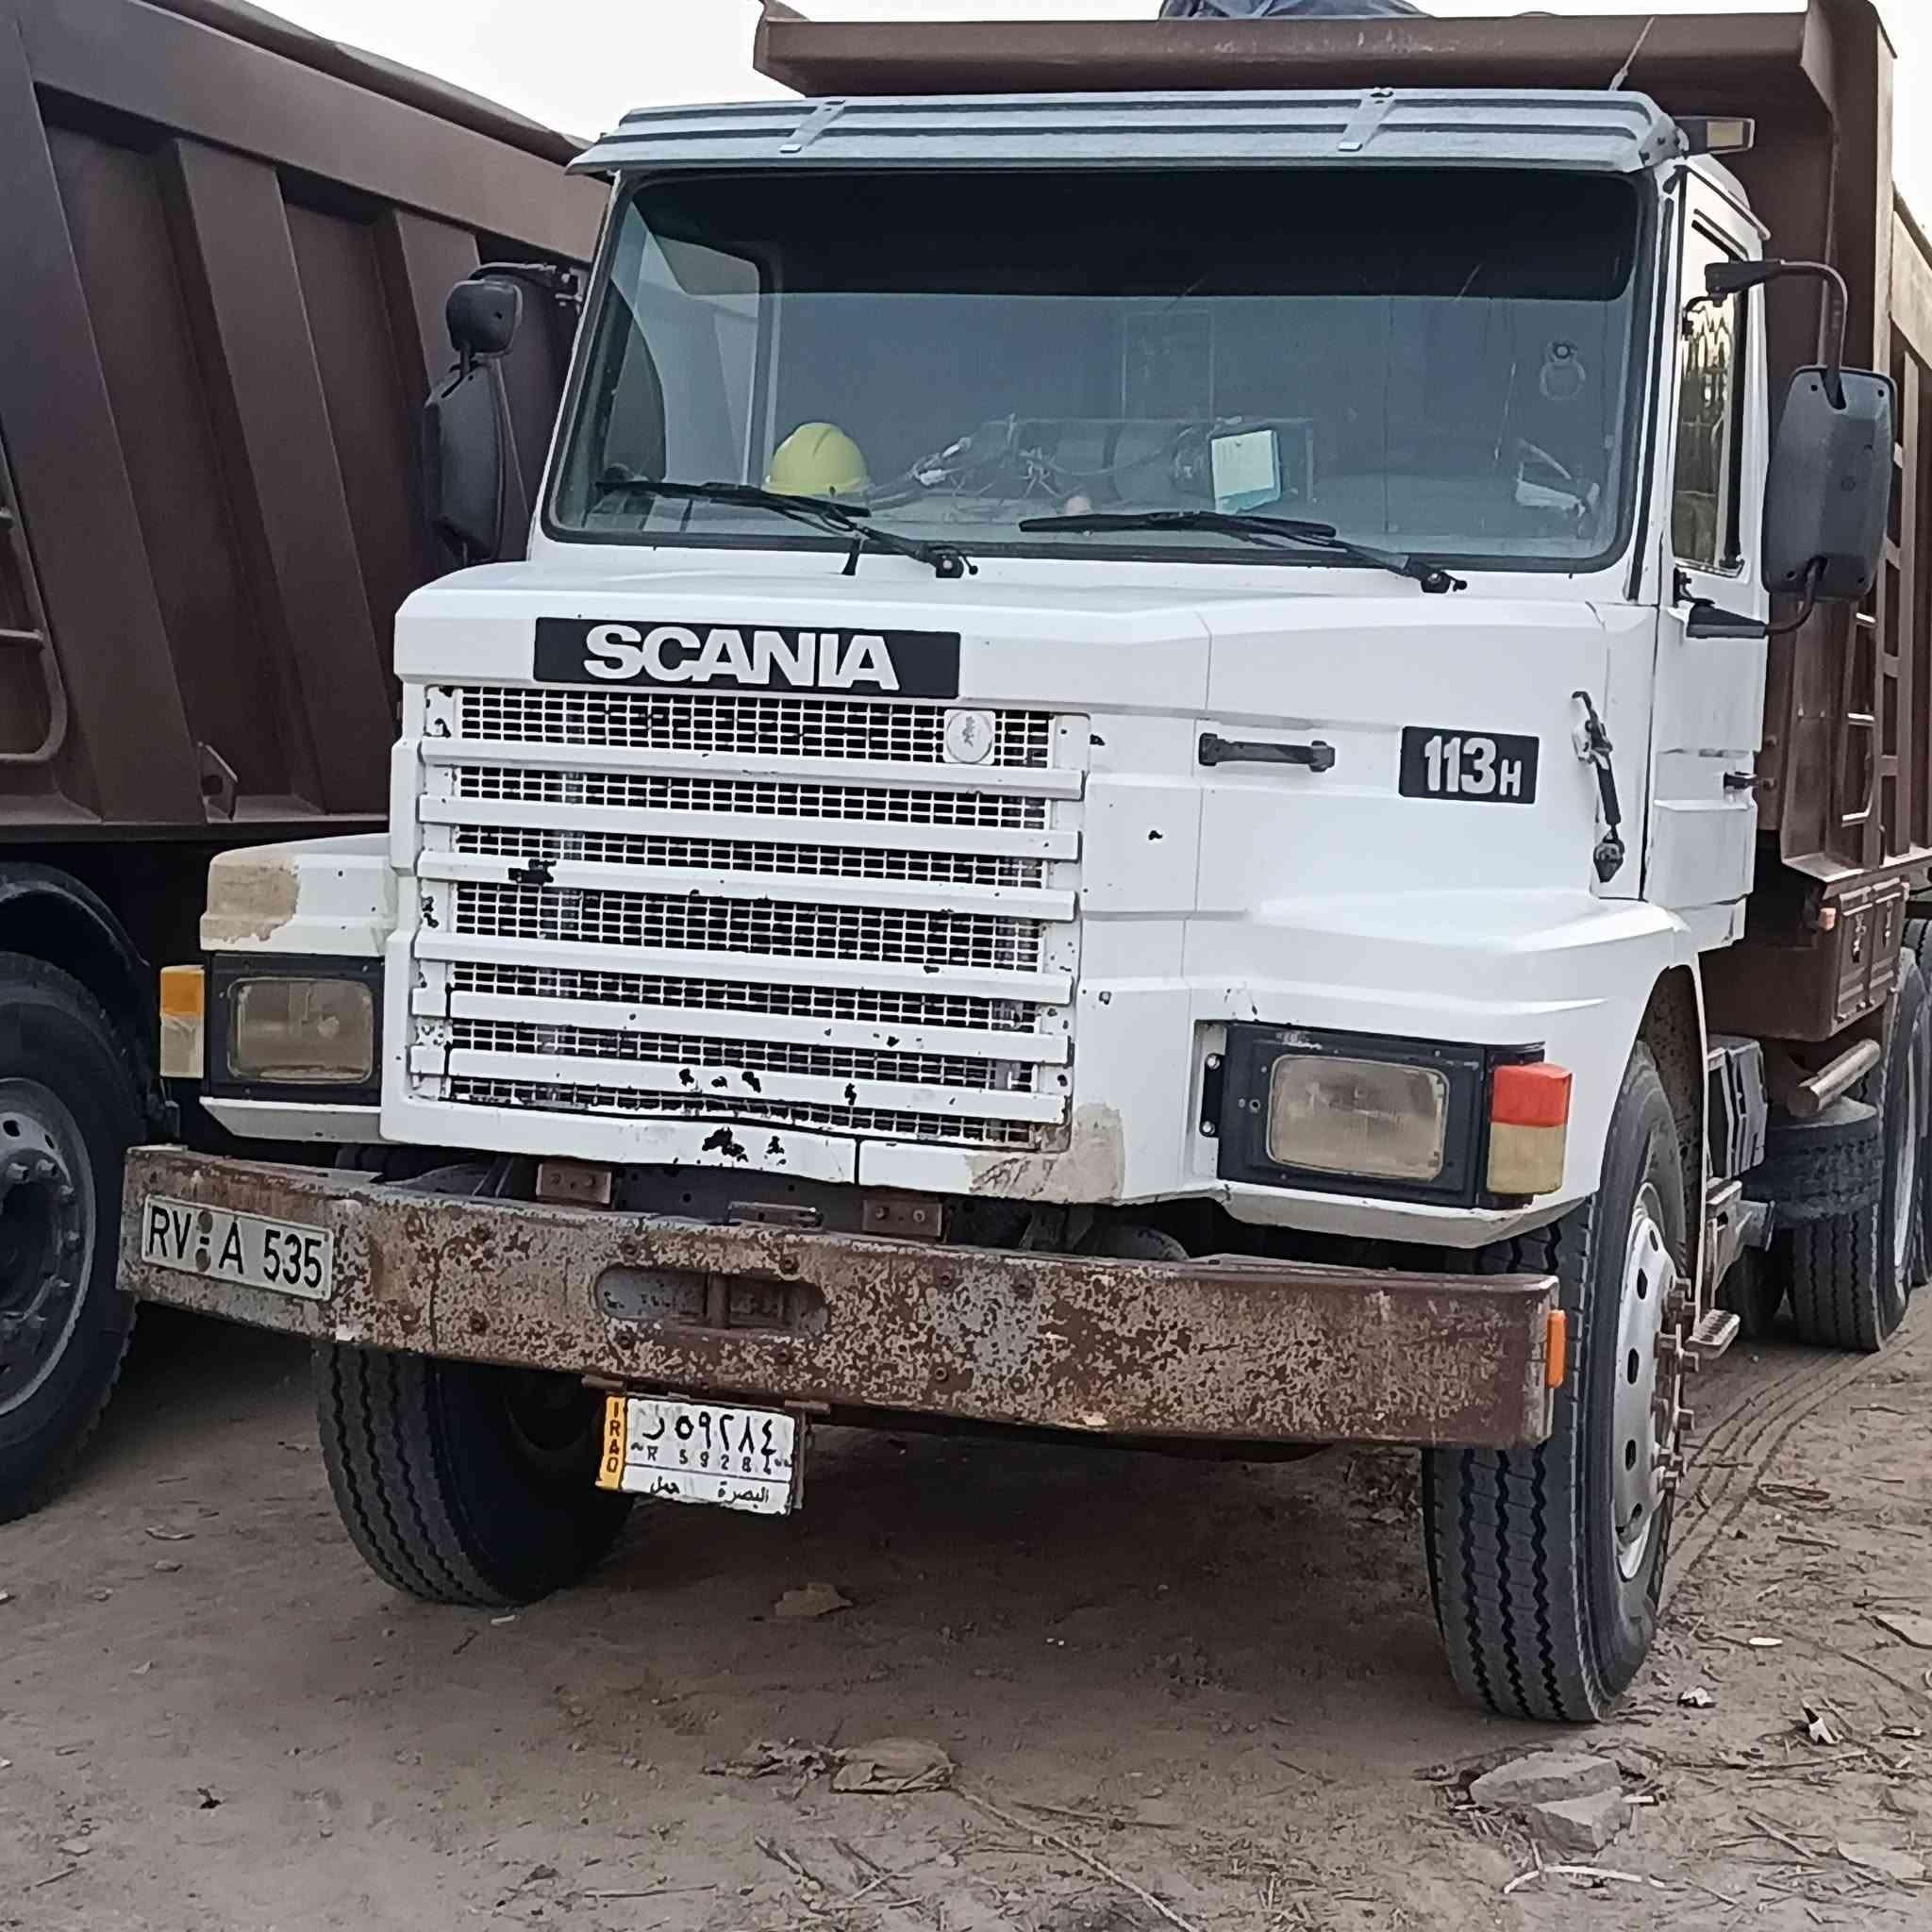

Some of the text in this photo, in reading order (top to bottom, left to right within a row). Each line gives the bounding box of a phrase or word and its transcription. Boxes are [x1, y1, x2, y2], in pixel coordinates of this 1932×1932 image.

[583, 624, 900, 691] SCANIA
[263, 1228, 324, 1289] 535
[605, 1401, 623, 1474] IRAQ
[649, 1475, 770, 1509] البصرة حمل
